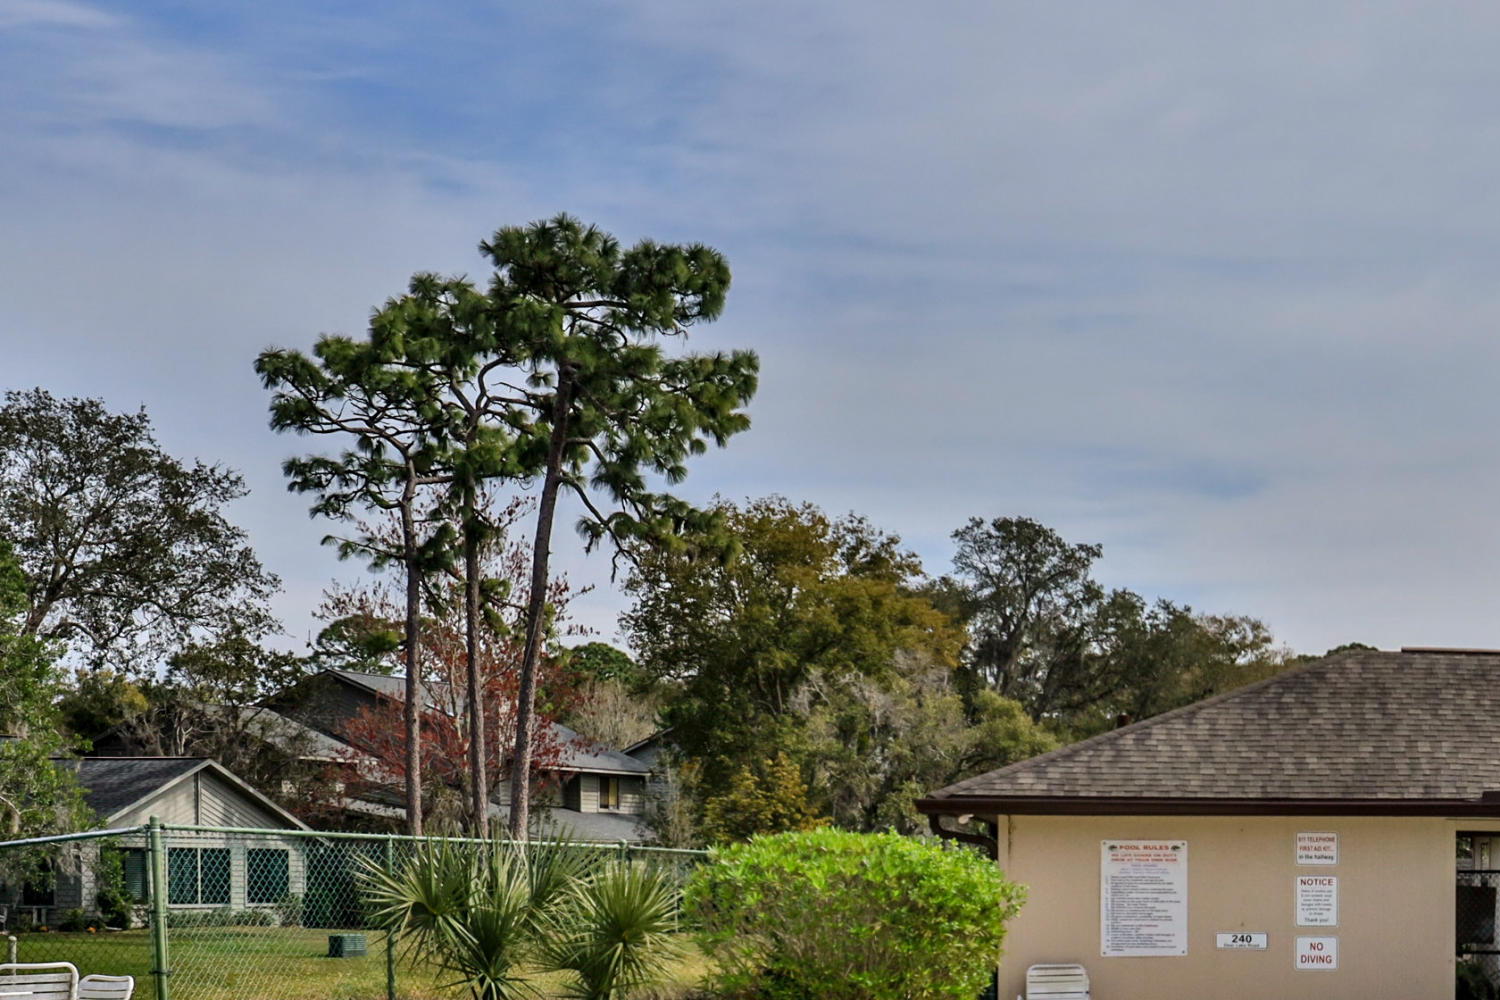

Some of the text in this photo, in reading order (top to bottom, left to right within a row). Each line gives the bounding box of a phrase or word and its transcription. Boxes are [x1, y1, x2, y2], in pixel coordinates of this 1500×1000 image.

[1300, 878, 1334, 886] NOTICE
[1231, 934, 1252, 944] 240
[1310, 942, 1324, 951] NO
[1300, 954, 1332, 964] DIVING
